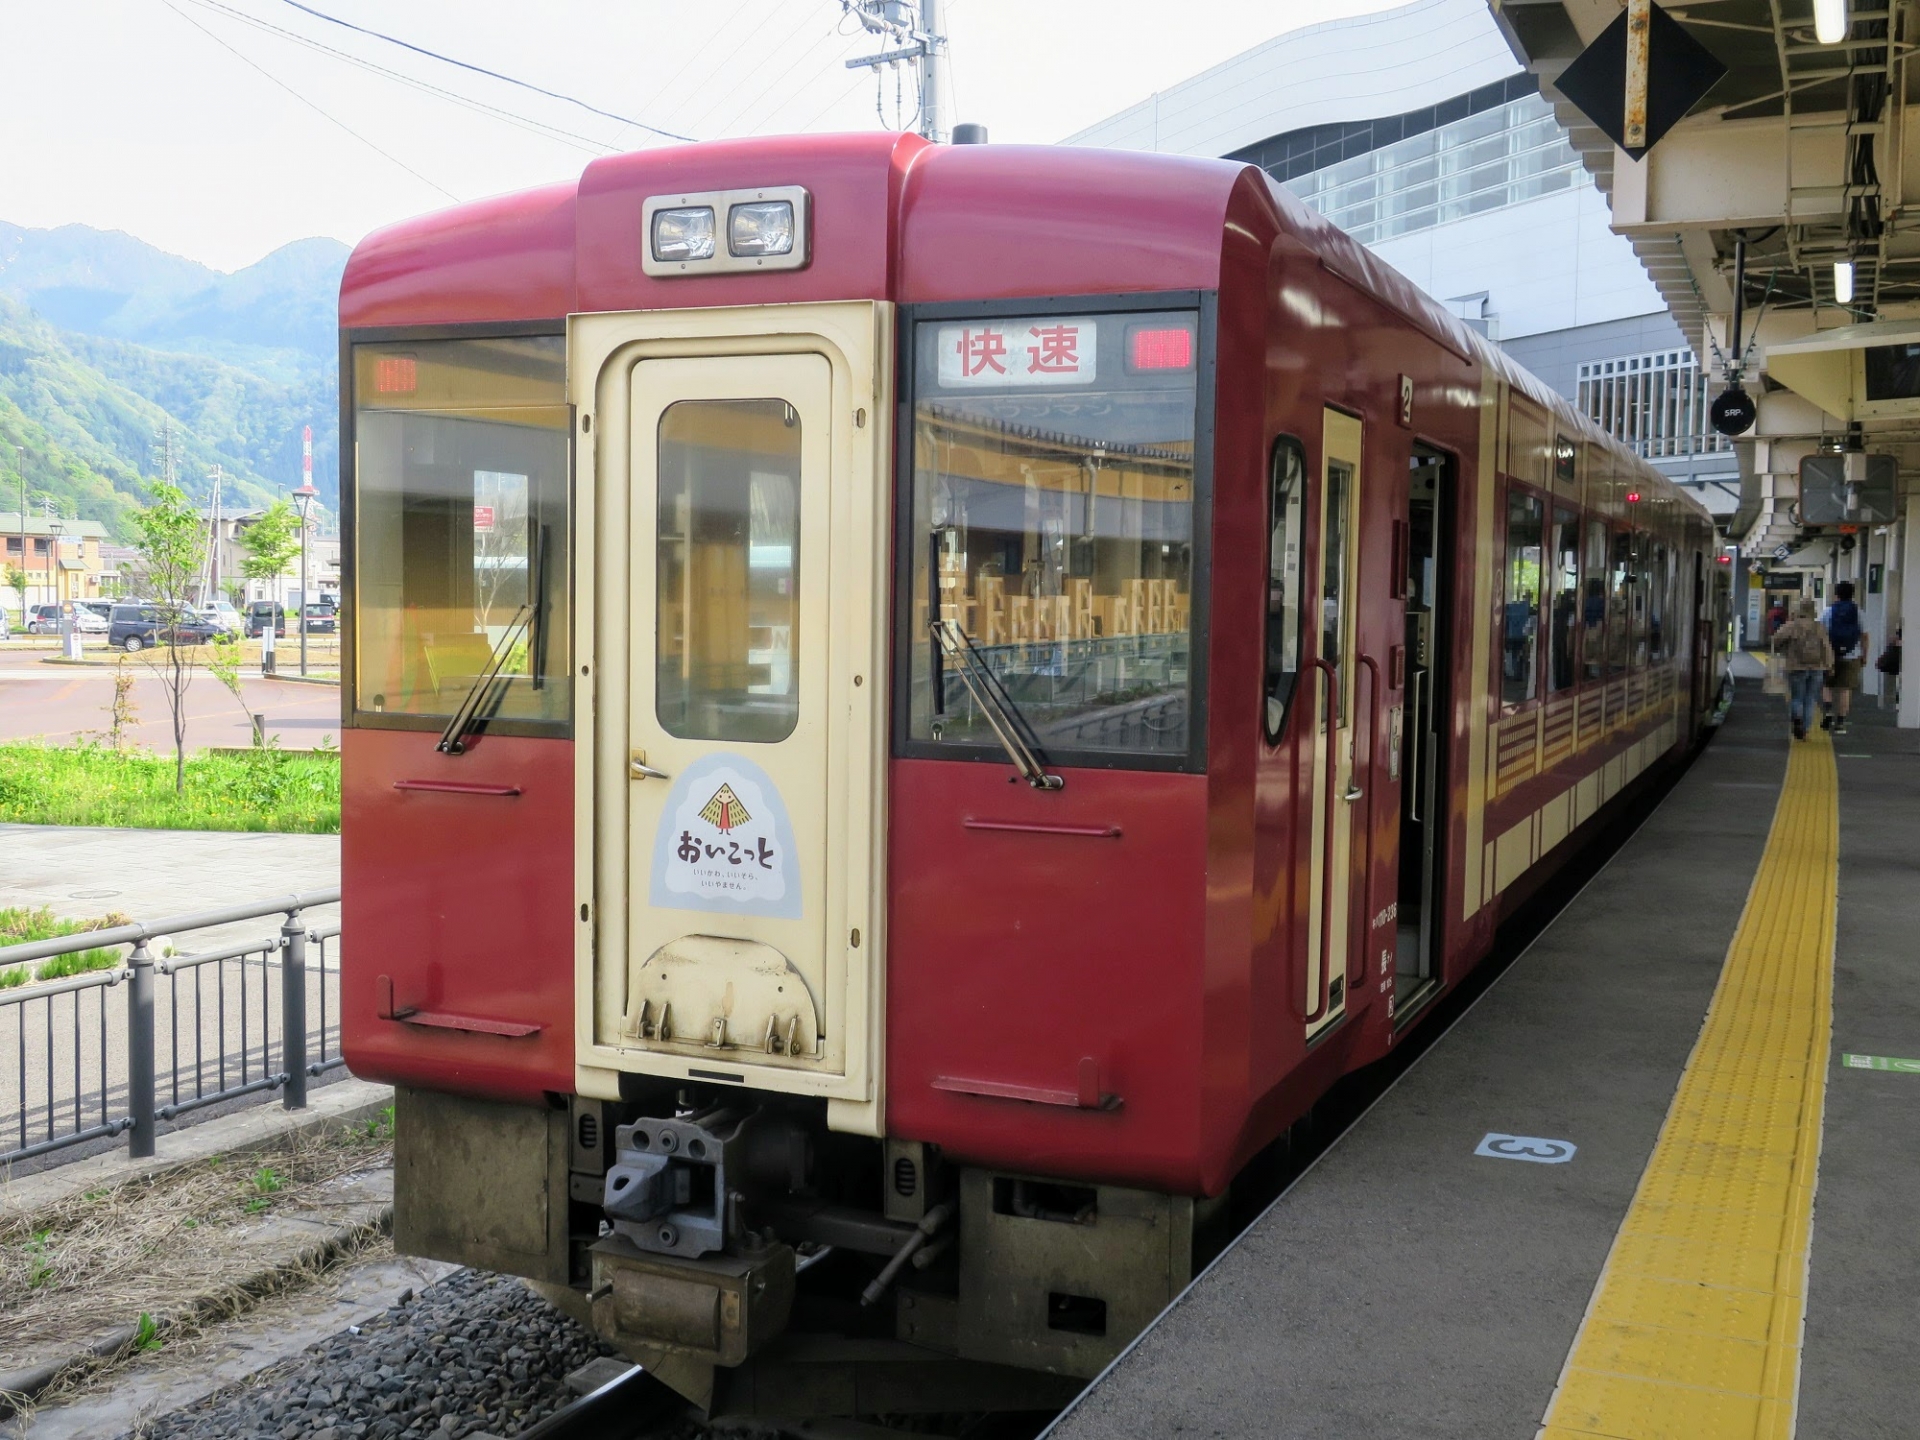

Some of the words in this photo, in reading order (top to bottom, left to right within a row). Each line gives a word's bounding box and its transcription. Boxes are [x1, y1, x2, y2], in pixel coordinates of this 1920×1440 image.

[956, 323, 1080, 377] 快速
[1404, 385, 1410, 418] 2
[1778, 548, 1785, 557] 2
[1870, 567, 1877, 581] 1
[677, 830, 774, 869] おいこっと
[701, 881, 747, 890] いいやません。
[1488, 1139, 1566, 1158] 3
